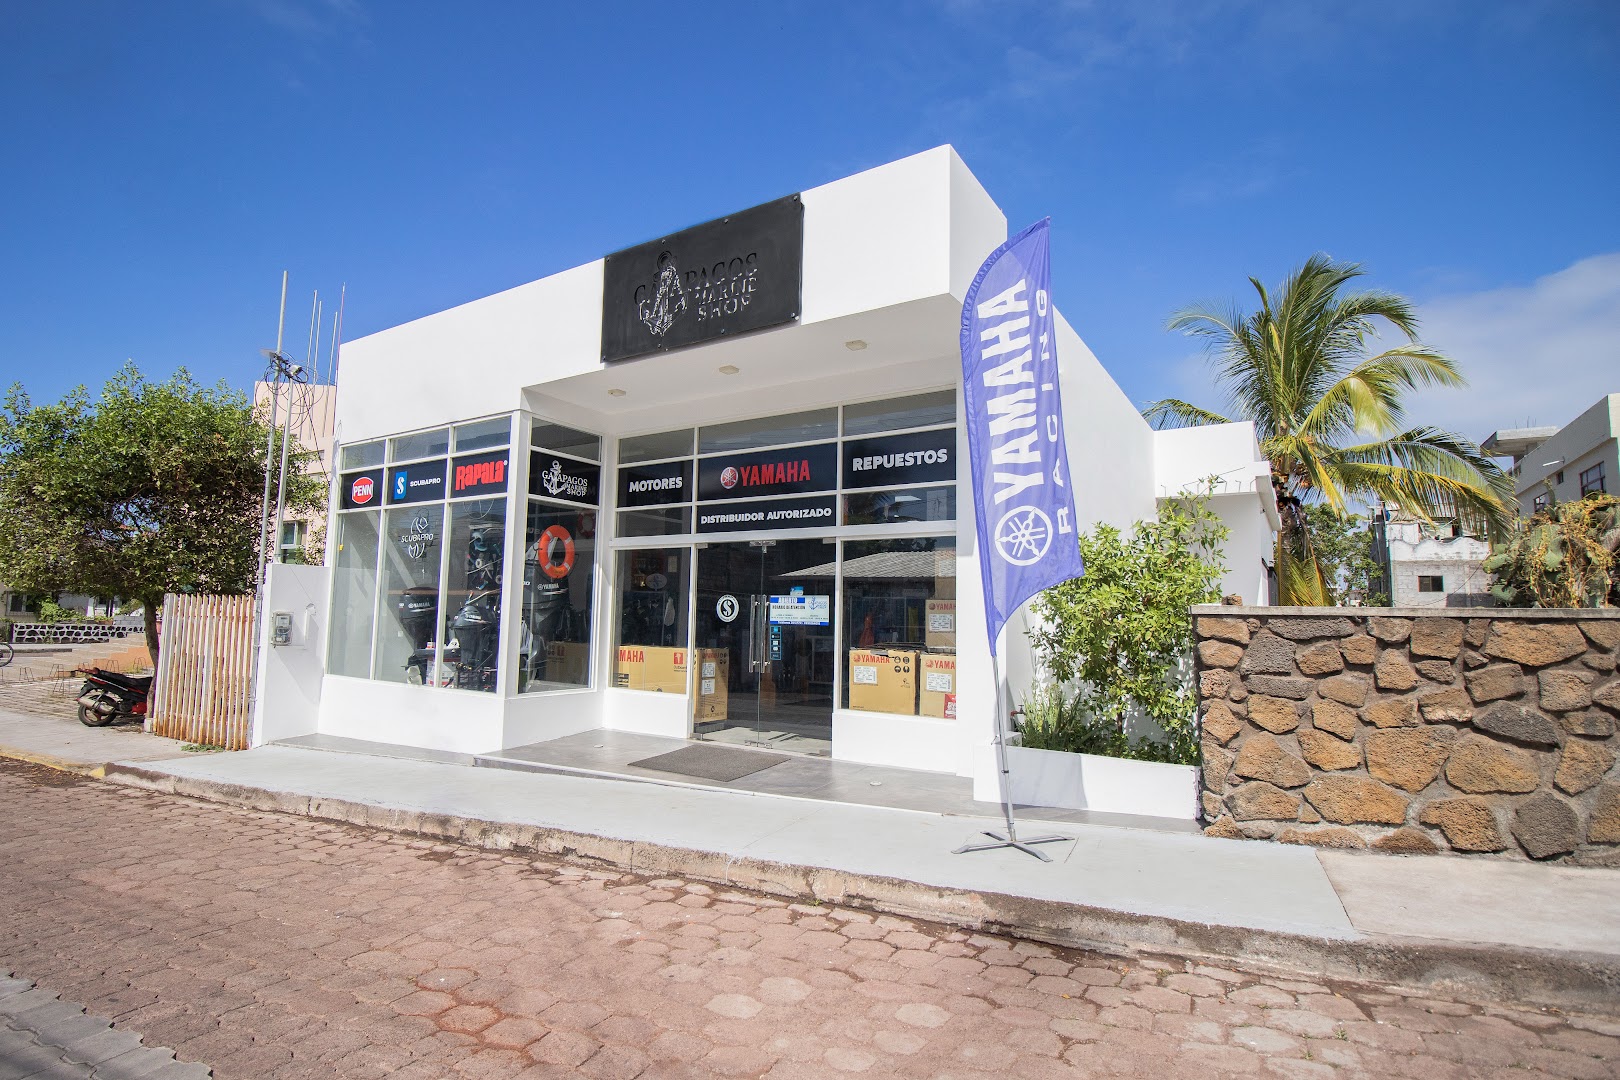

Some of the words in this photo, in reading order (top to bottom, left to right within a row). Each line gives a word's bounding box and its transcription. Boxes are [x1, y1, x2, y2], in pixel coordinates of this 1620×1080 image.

[977, 279, 1046, 505] YAMAHA
[1035, 288, 1073, 535] RACING
[852, 449, 948, 472] REPUESTOS
[740, 460, 811, 487] YAMAHA
[410, 477, 441, 487] SCUBAPRO
[629, 476, 683, 492] MOTORES
[352, 484, 374, 497] PENN
[566, 488, 587, 497] SHOP
[700, 512, 765, 524] DISTRIBUIDOR
[766, 508, 832, 520] AUTORIZADO
[400, 533, 434, 543] SCUBAPRO
[618, 649, 645, 662] MAHA
[861, 654, 891, 664] YAMAHA
